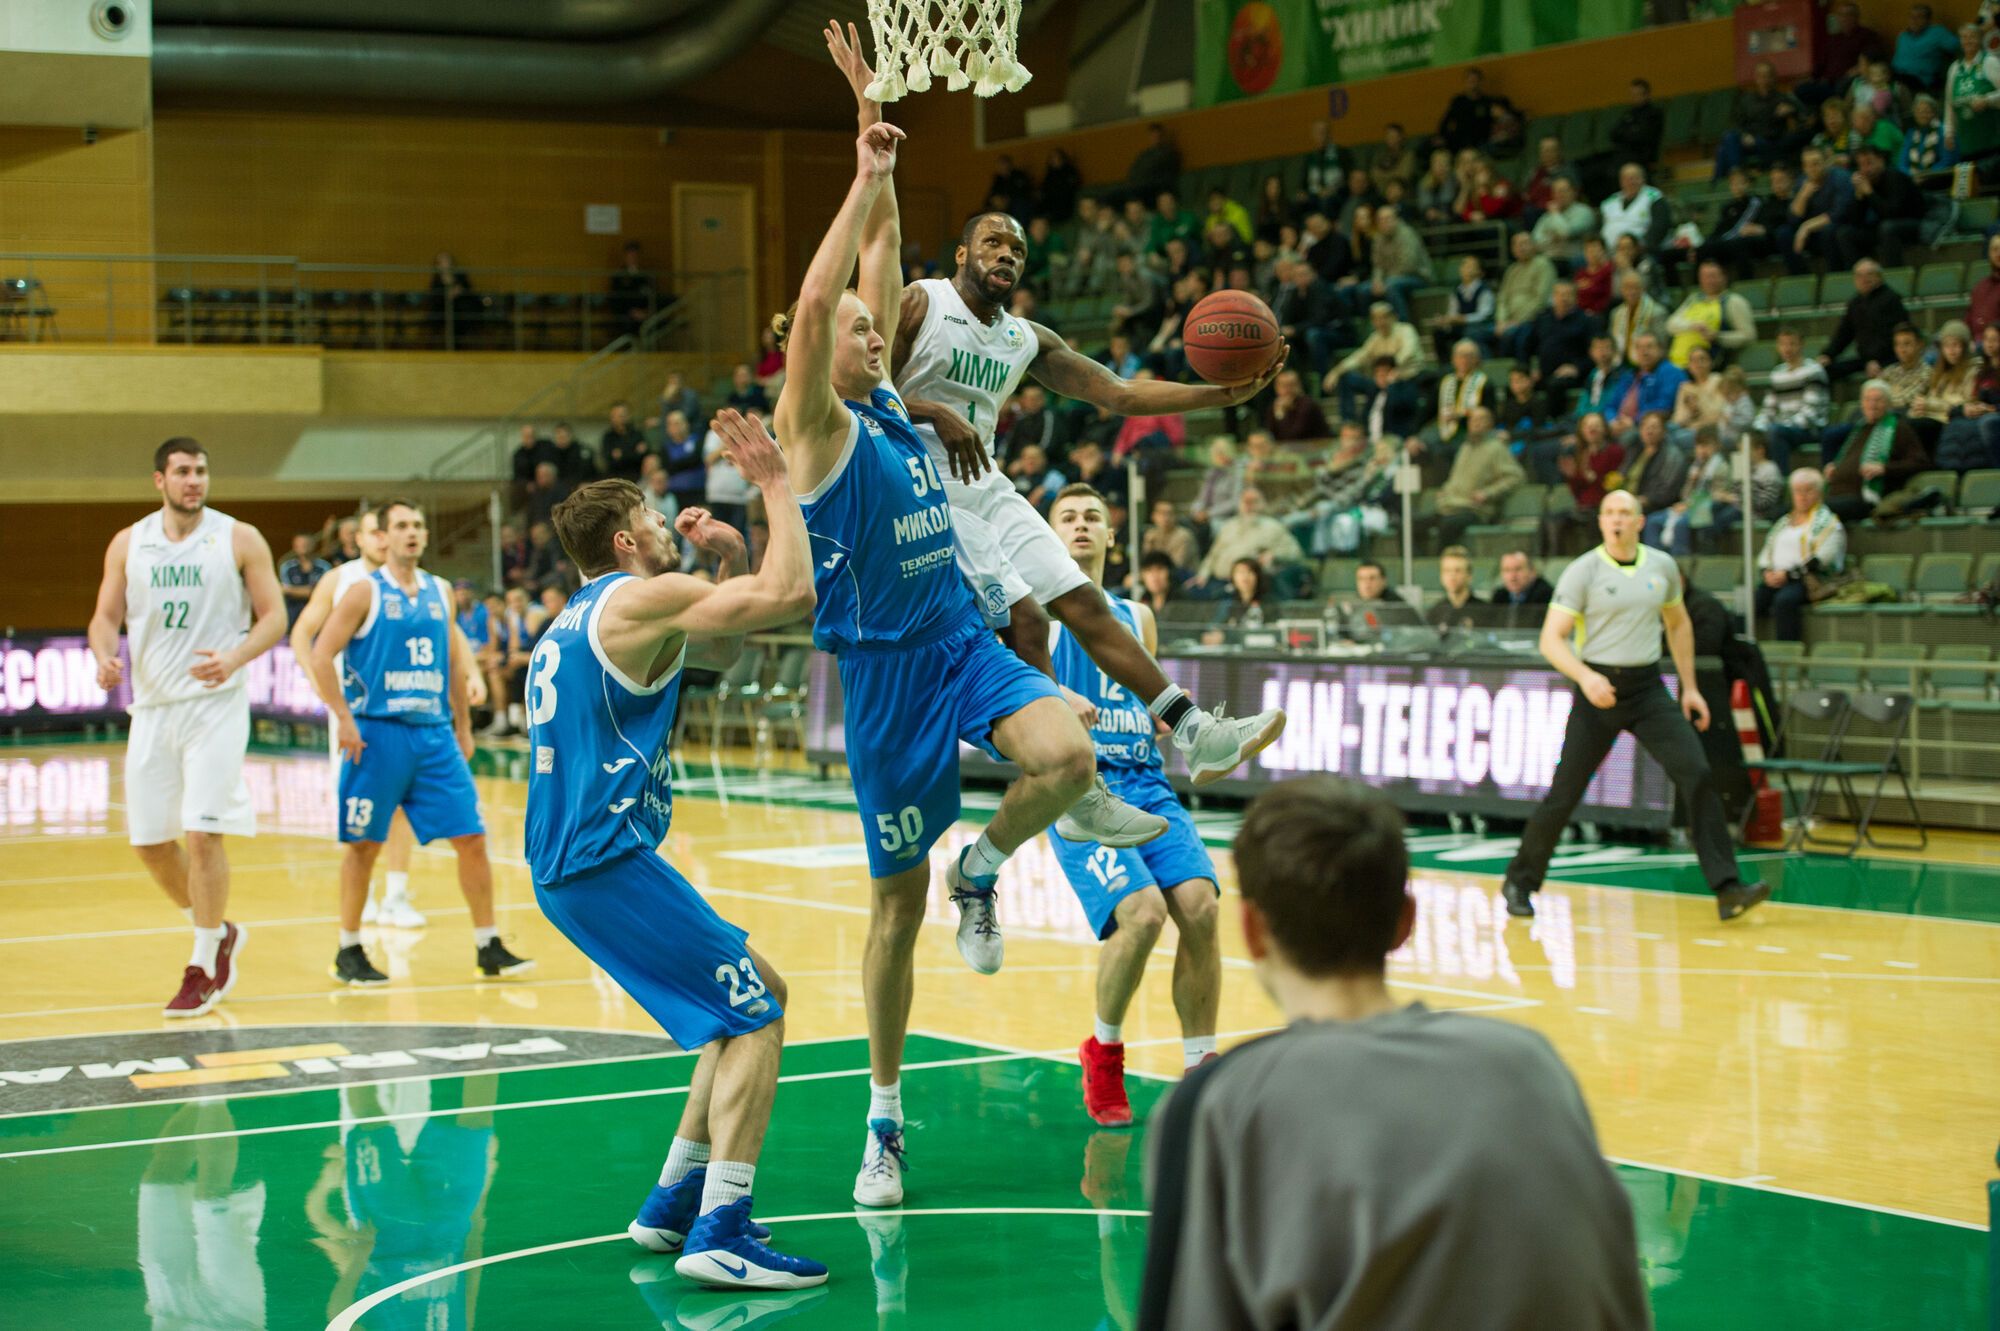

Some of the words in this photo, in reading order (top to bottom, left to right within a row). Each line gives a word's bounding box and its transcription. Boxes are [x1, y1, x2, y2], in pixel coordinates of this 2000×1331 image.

[1198, 322, 1262, 340] Wilson
[968, 400, 976, 424] 1
[151, 565, 203, 588] XIMIK
[163, 601, 190, 629] 22
[405, 637, 435, 666] 13
[1259, 679, 1574, 787] LAN-TELECOM
[346, 797, 374, 827] 13
[876, 805, 924, 852] 50
[1085, 845, 1127, 887] 12
[715, 957, 766, 1008] 23
